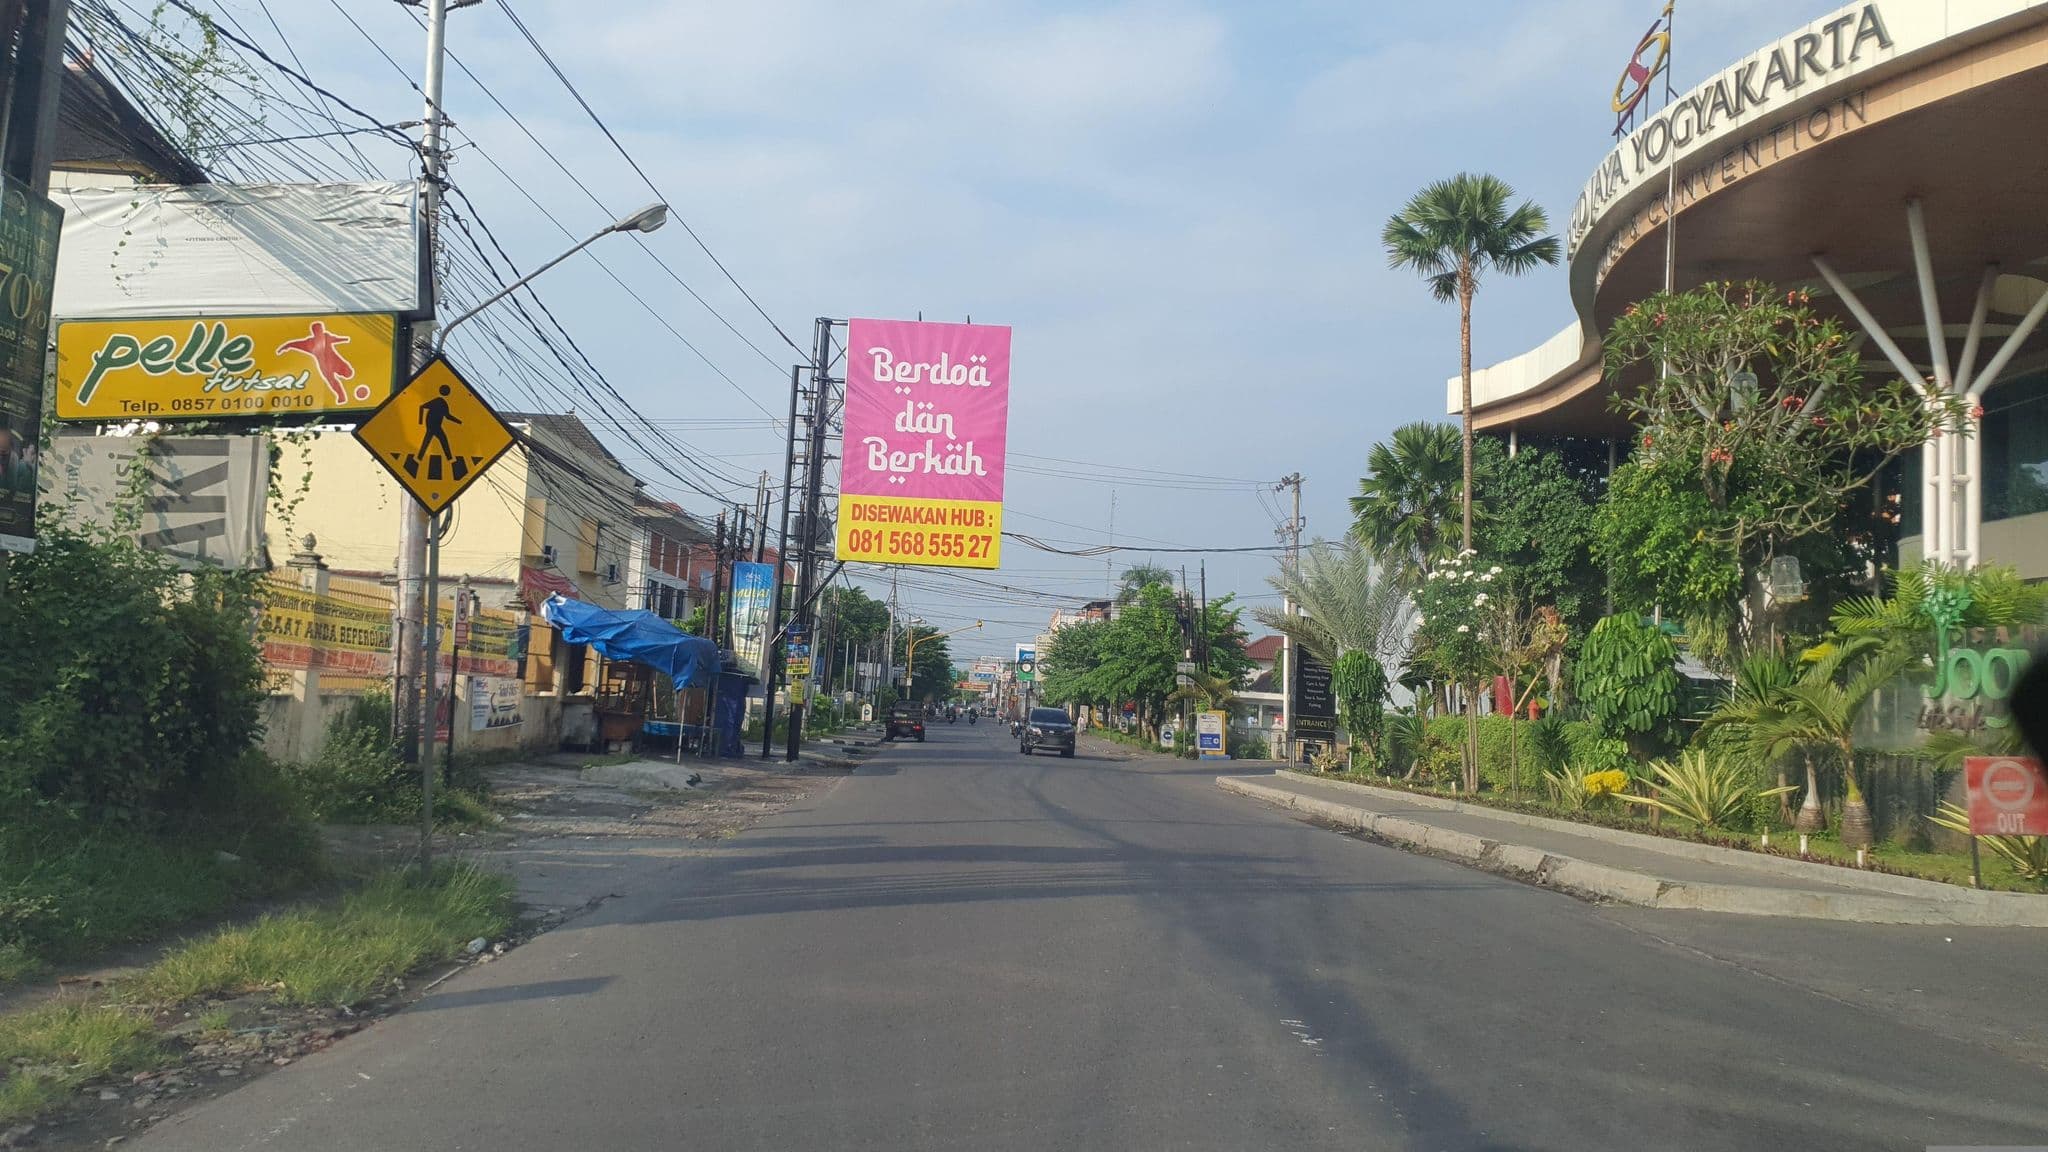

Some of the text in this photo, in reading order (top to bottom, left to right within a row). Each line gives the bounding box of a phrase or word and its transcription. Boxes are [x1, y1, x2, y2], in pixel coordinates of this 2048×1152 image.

[1630, 2, 1894, 174] YOGYAKARTA
[1647, 90, 1867, 226] CONVENTION
[76, 321, 255, 406] pelle
[203, 368, 312, 393] futsal
[119, 394, 315, 415] Telp. 0857 0100 0010
[65, 463, 79, 521] BAERY
[141, 439, 229, 566] AKI
[851, 503, 947, 525] DISEWAKAN
[849, 528, 993, 559] 081 568 555 27
[304, 620, 337, 642] ANDA
[1998, 812, 2026, 833] OUT
